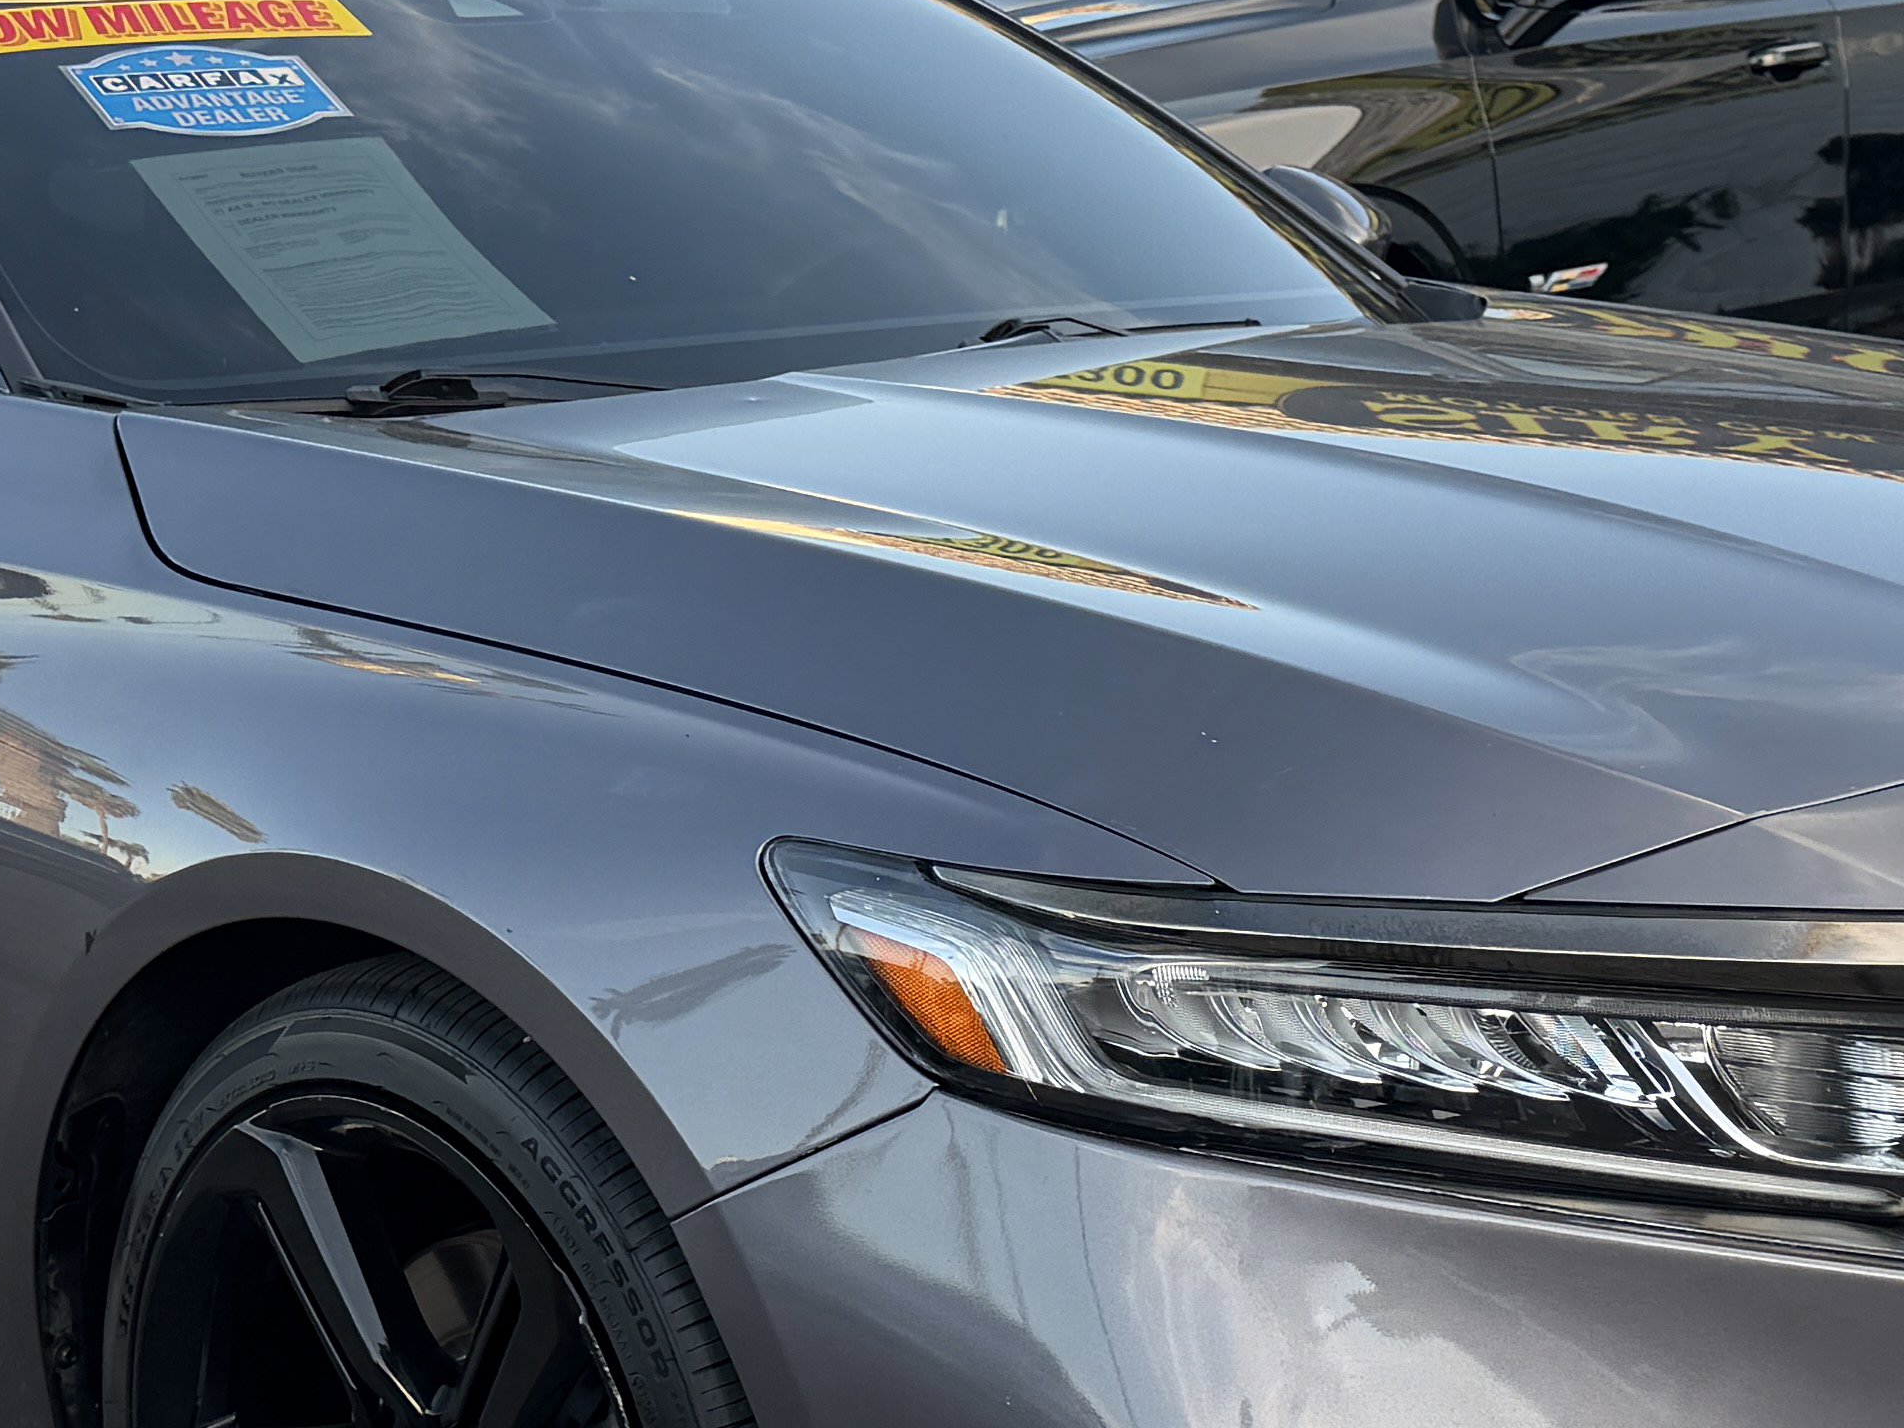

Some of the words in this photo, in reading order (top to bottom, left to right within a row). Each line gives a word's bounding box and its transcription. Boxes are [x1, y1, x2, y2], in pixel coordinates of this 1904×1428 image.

[100, 69, 293, 93] CARFAX
[132, 89, 304, 113] ADVANTAGE
[172, 107, 290, 128] DEALER
